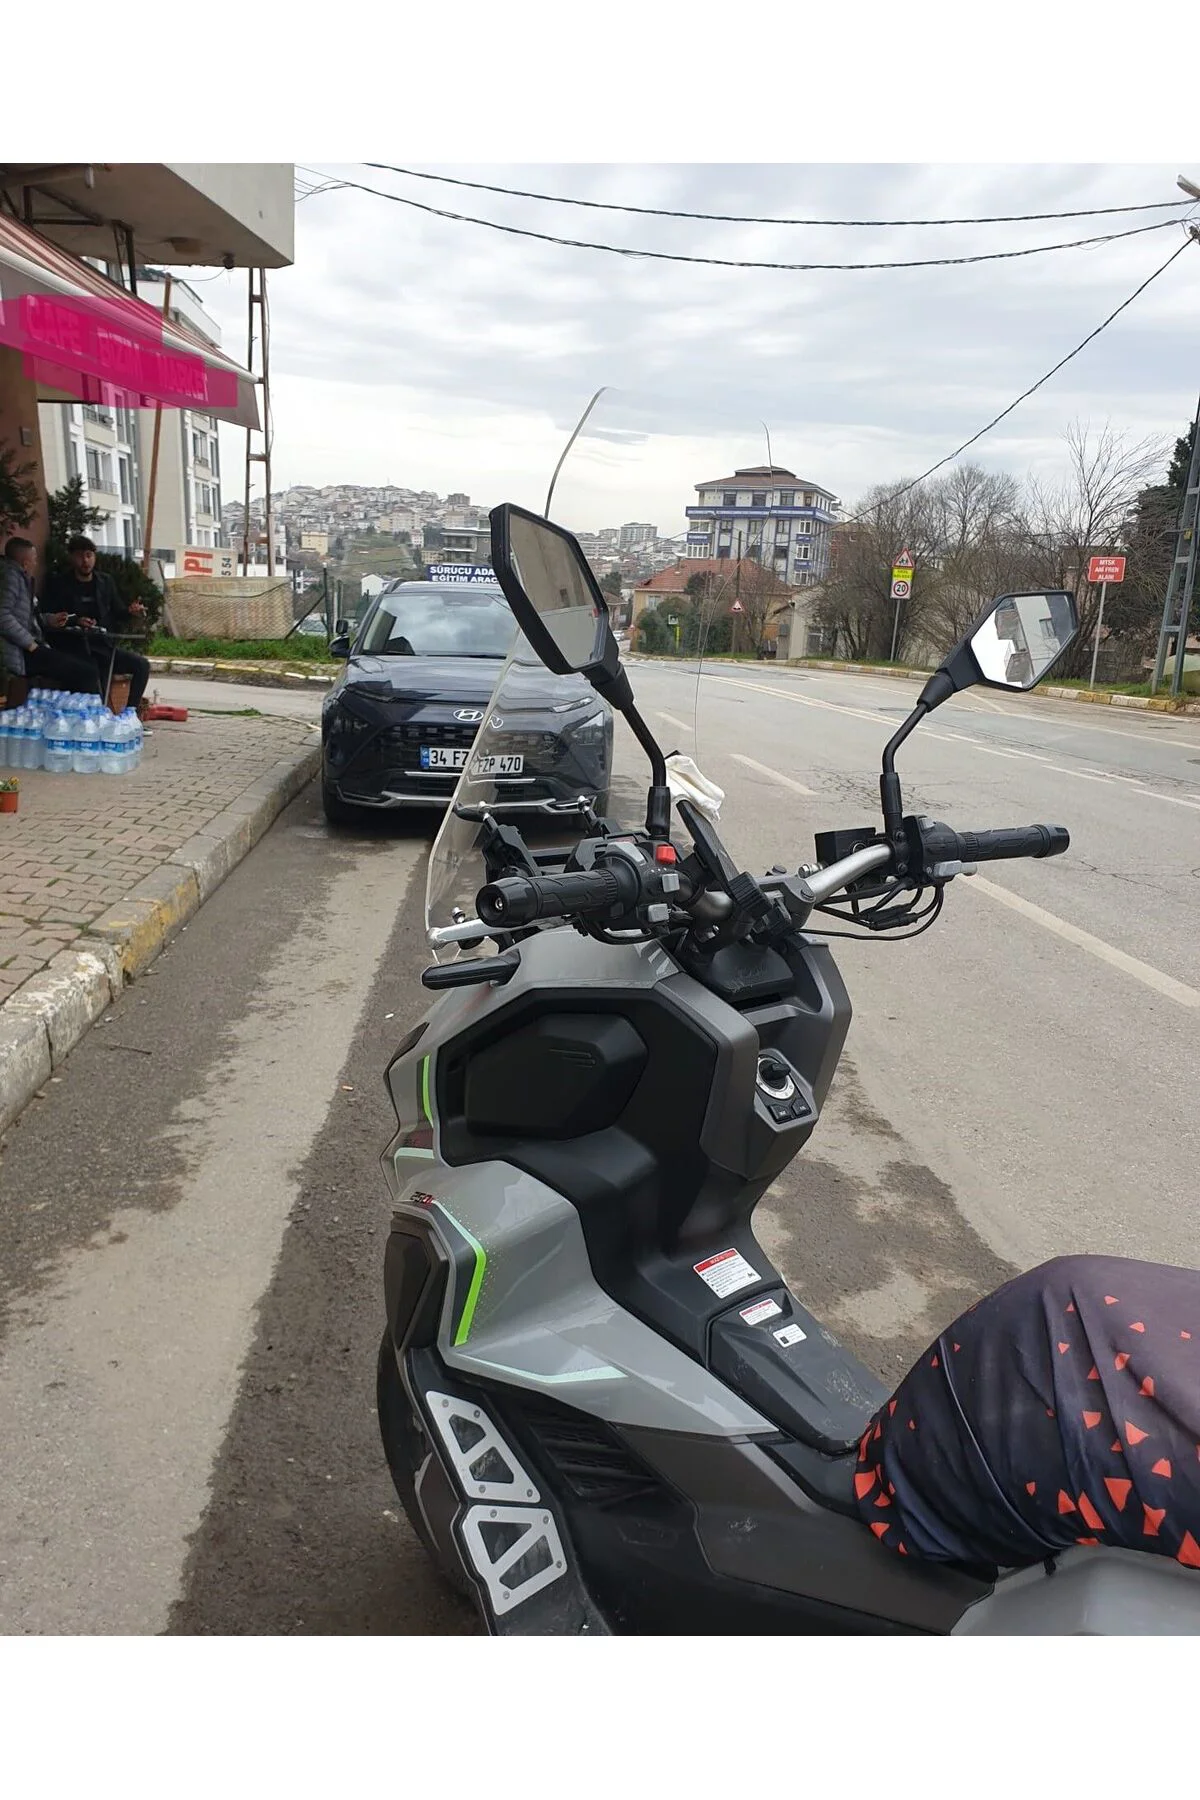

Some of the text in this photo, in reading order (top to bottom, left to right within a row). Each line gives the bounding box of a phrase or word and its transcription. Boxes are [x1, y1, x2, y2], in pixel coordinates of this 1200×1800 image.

[184, 551, 213, 578] PI
[896, 584, 906, 592] 20
[431, 750, 447, 765] 34
[500, 757, 521, 772] 470
